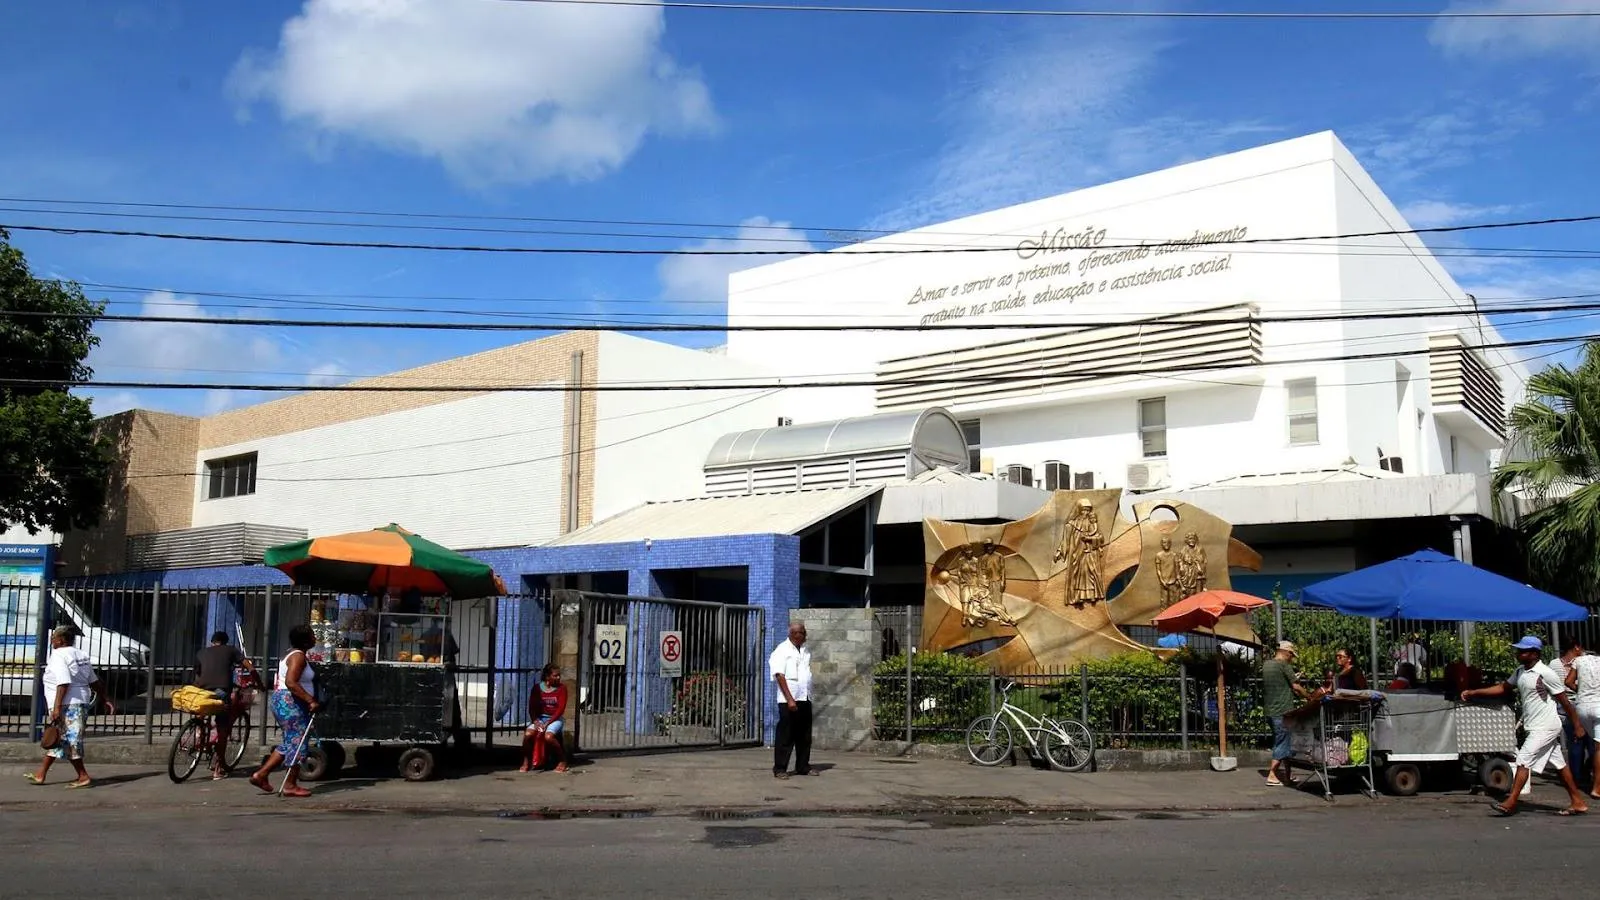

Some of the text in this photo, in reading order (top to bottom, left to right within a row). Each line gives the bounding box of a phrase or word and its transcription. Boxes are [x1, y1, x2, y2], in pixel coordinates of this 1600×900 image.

[907, 286, 949, 305] Amar
[951, 285, 959, 296] e
[961, 276, 996, 295] servir
[997, 273, 1013, 288] ao
[1078, 240, 1151, 277] oferecendo
[1154, 225, 1247, 257] atendimento
[1017, 226, 1106, 259] Missão
[919, 305, 966, 331] gratuito
[969, 303, 988, 317] na
[1033, 284, 1095, 304] educação
[1098, 279, 1107, 293] e
[1110, 266, 1185, 291] assistência
[599, 639, 621, 659] 02
